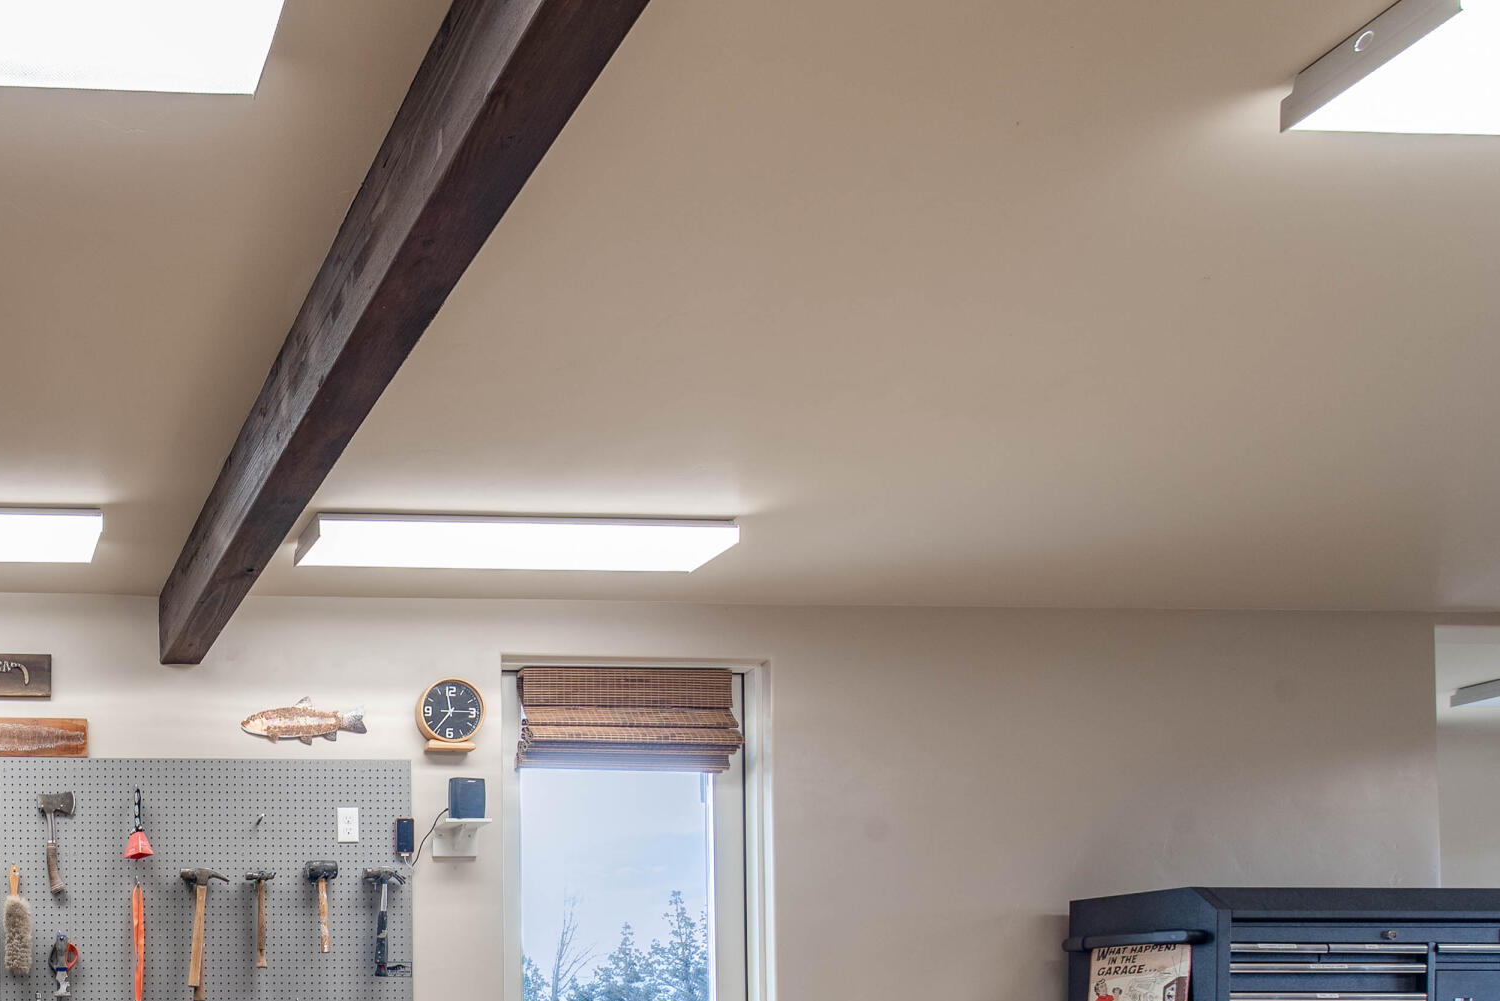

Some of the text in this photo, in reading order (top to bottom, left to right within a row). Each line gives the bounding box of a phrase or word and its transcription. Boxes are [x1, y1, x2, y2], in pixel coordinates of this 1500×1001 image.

[446, 686, 456, 697] 12
[424, 706, 432, 717] 9
[468, 707, 476, 718] 3
[445, 728, 454, 738] 6
[1097, 943, 1177, 961] WHAT HAPPENS
[1108, 955, 1138, 965] IN THE
[1097, 964, 1157, 976] GARAGE...
